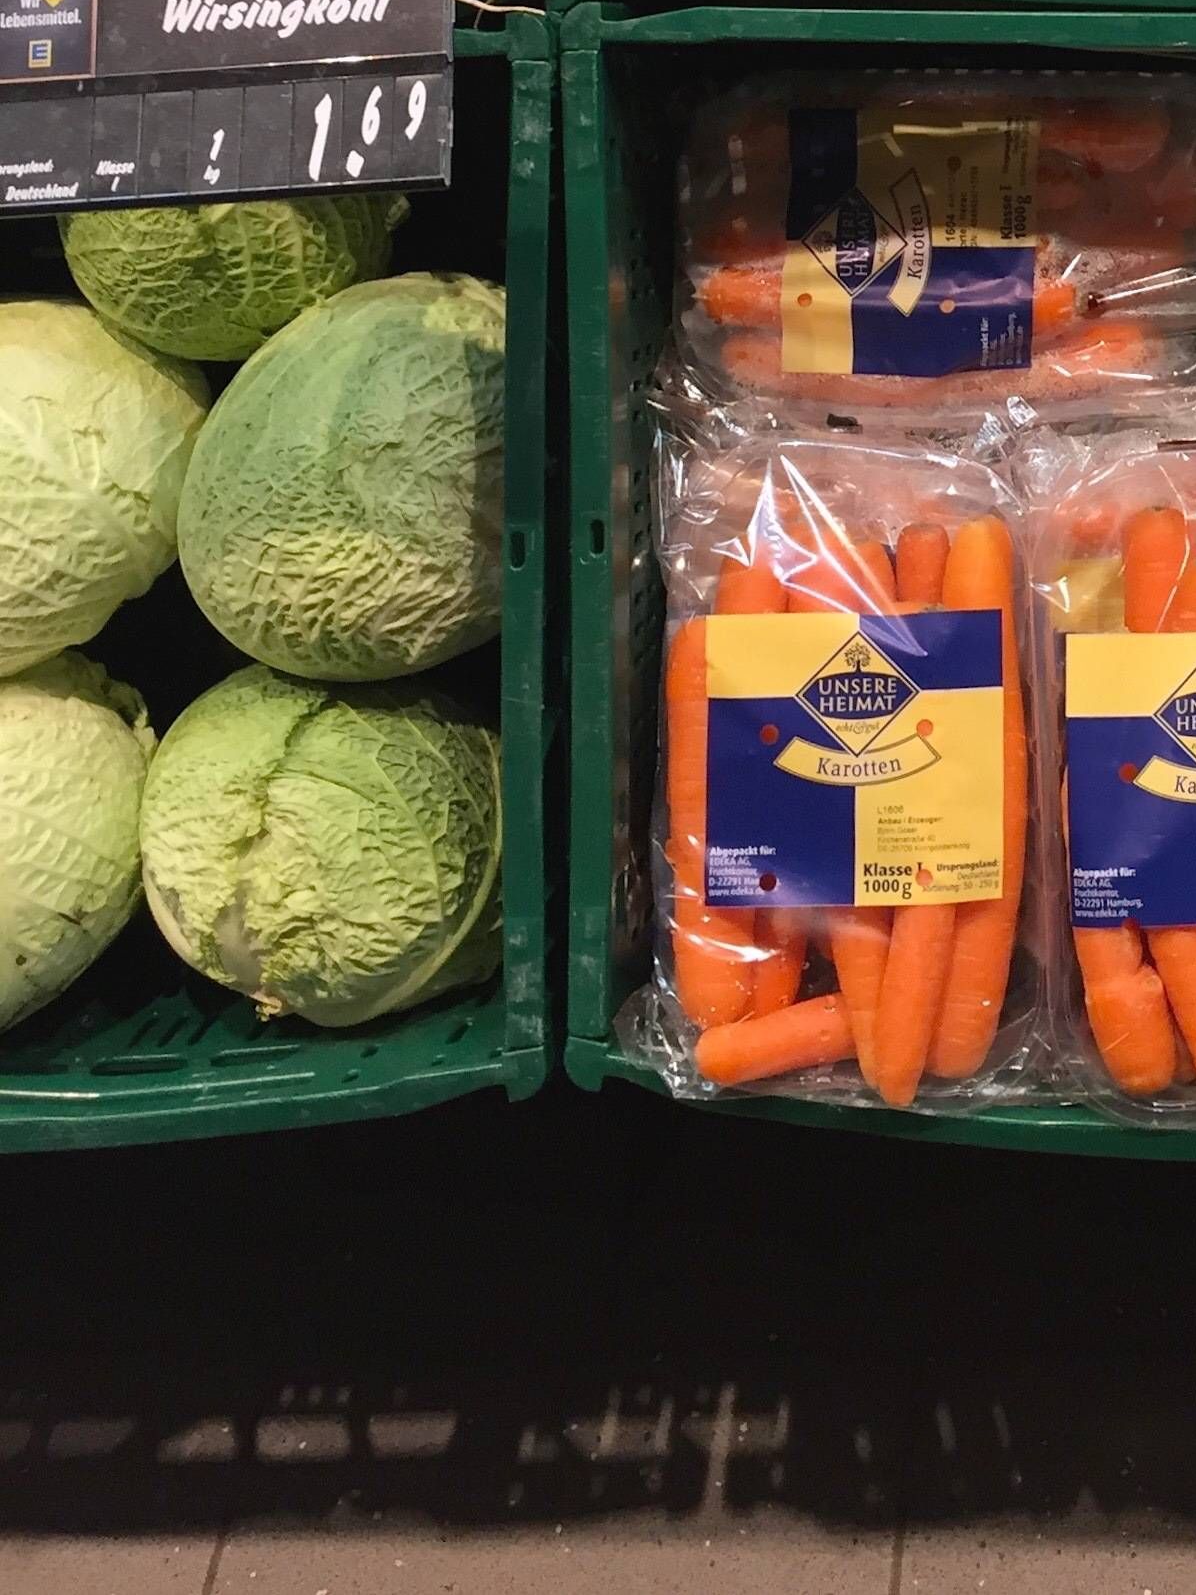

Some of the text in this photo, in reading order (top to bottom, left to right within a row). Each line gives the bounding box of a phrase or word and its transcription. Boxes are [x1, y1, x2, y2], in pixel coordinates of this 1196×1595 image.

[96, 160, 135, 176] Klasse
[5, 182, 79, 201] Deutschland
[1000, 194, 1012, 240] Klasse
[908, 205, 926, 279] Karotten
[819, 677, 897, 695] UNSERE
[820, 695, 896, 713] HEIMAT
[817, 757, 902, 777] Karotten
[710, 846, 758, 857] Abgepackt
[863, 863, 912, 877] Klasse
[1073, 867, 1136, 879] Abgepackt für:
